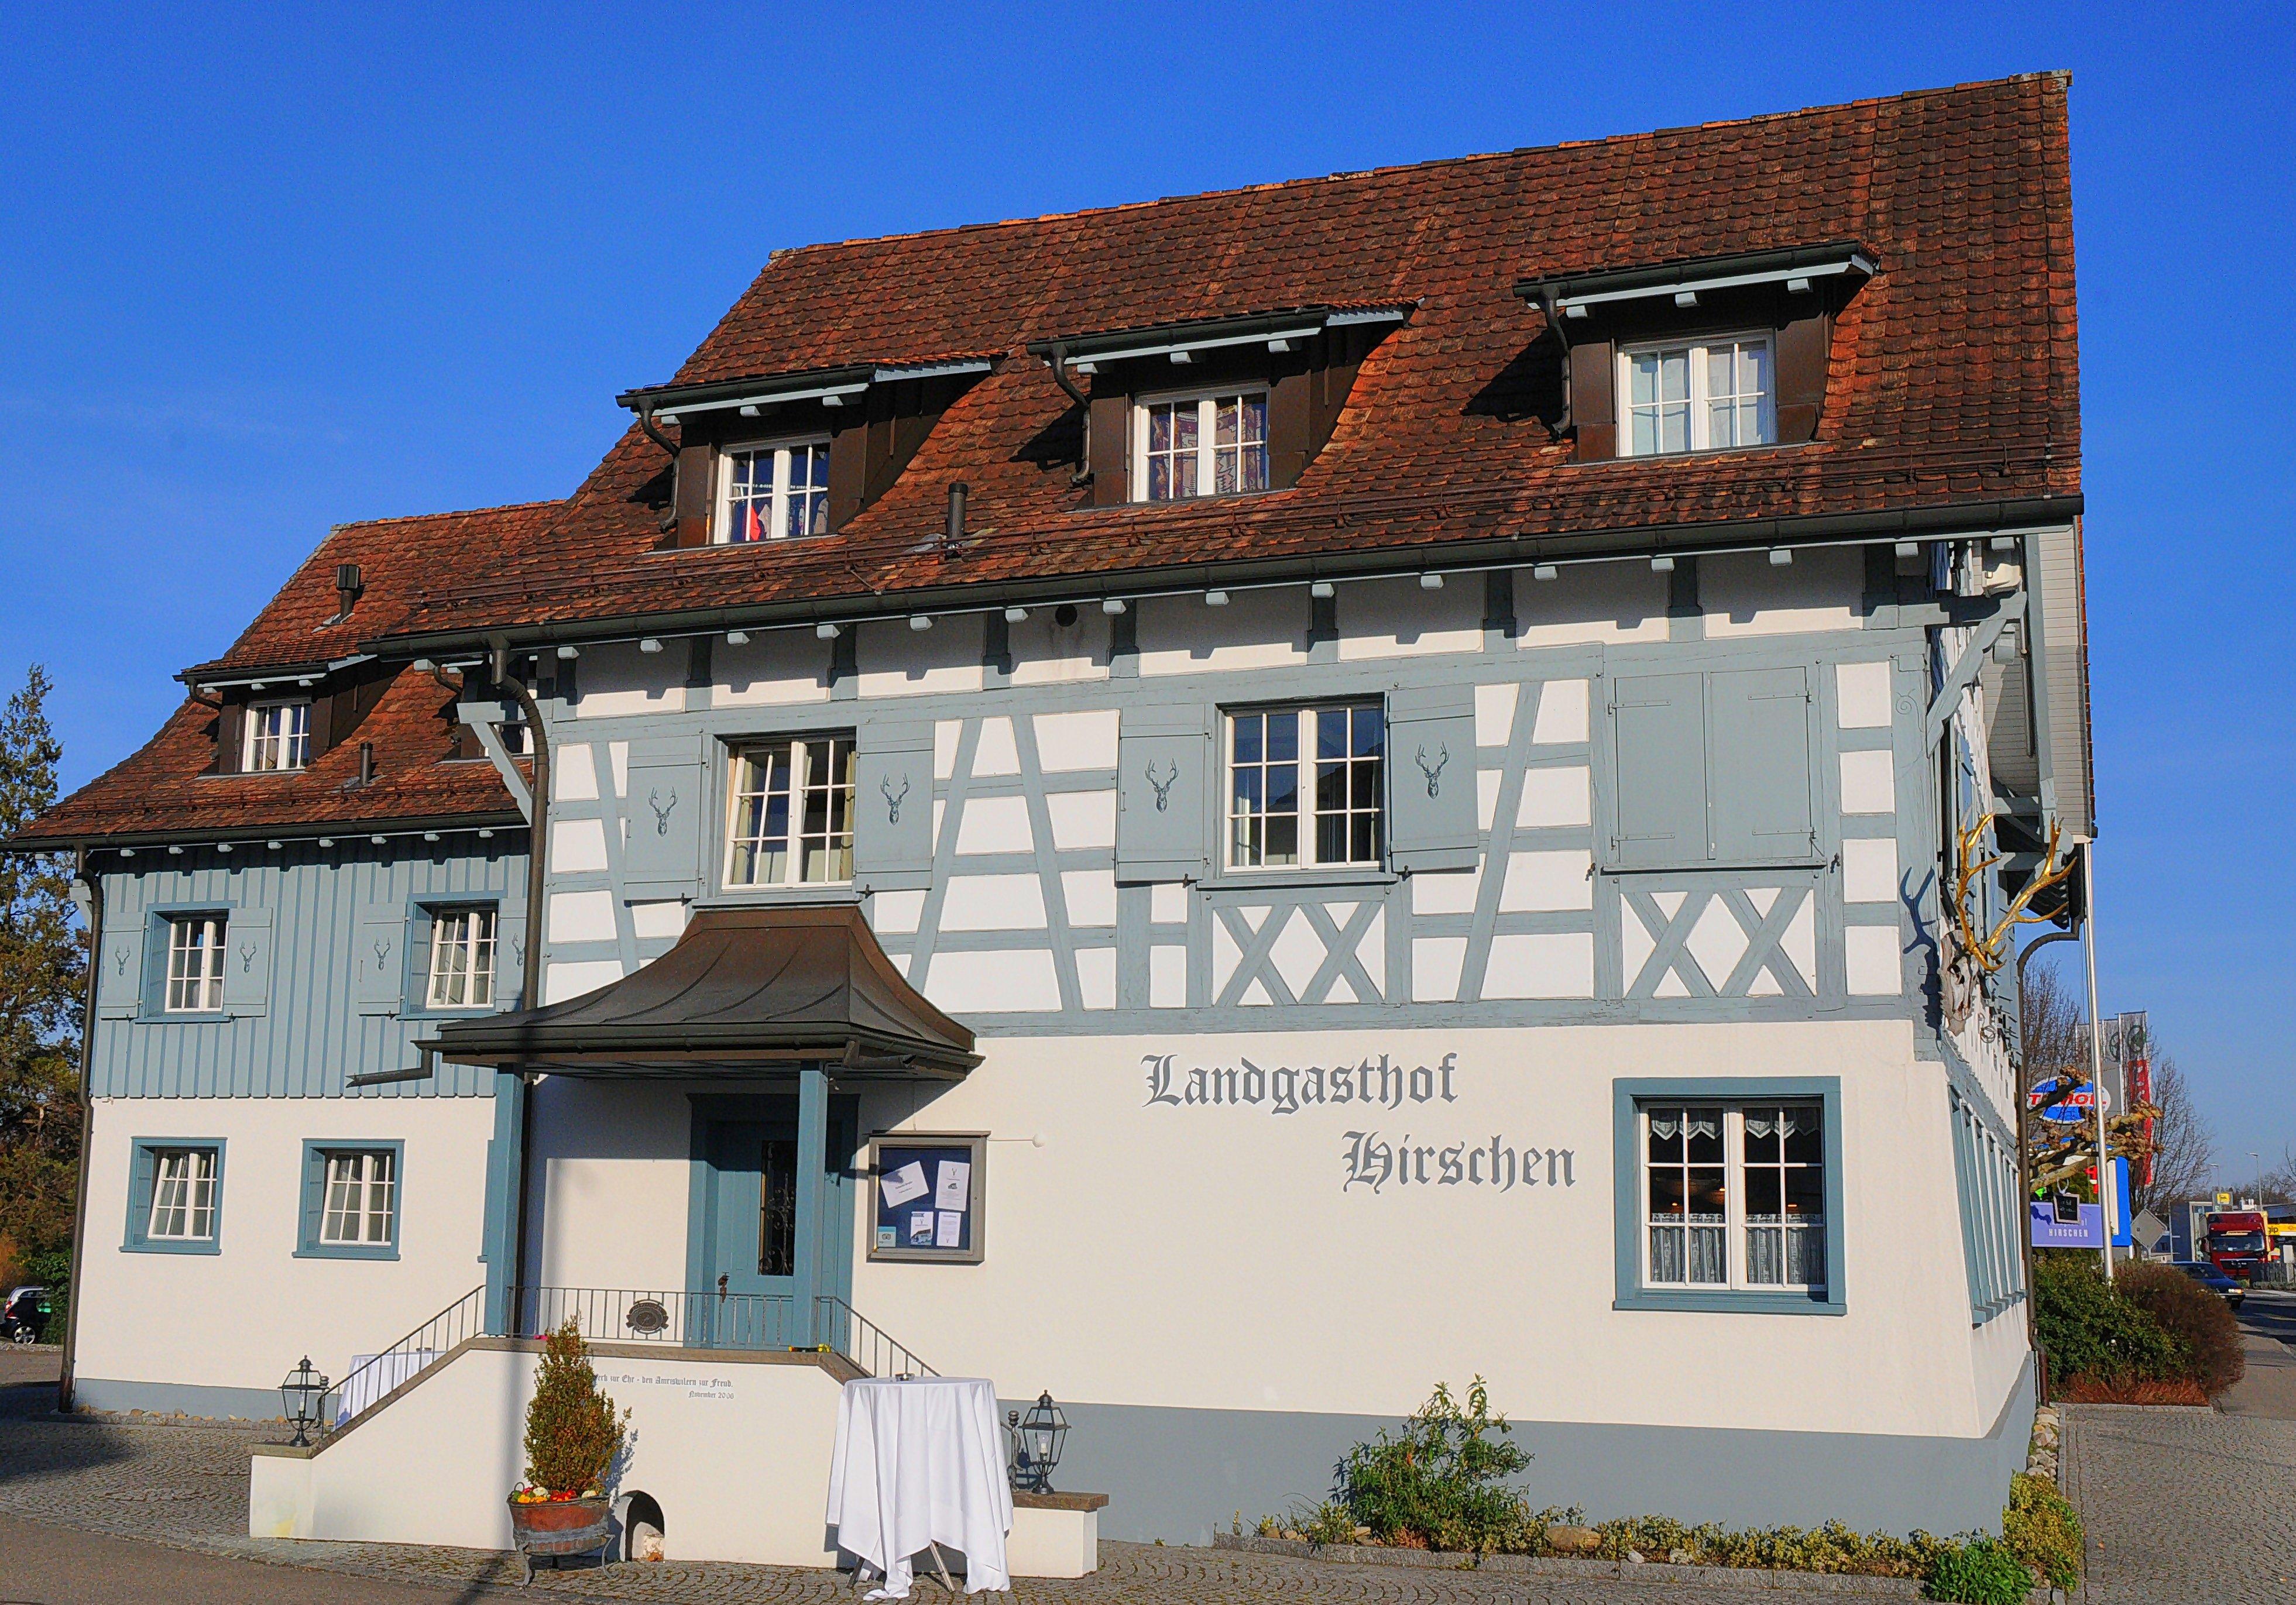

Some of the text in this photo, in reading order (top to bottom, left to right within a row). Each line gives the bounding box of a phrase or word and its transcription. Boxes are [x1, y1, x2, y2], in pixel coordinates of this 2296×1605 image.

[1141, 1052, 1458, 1115] Landgasthof
[1341, 1130, 1577, 1195] Hirschen
[2048, 1228, 2088, 1238] HIRSCHEN
[688, 1390, 716, 1398] November
